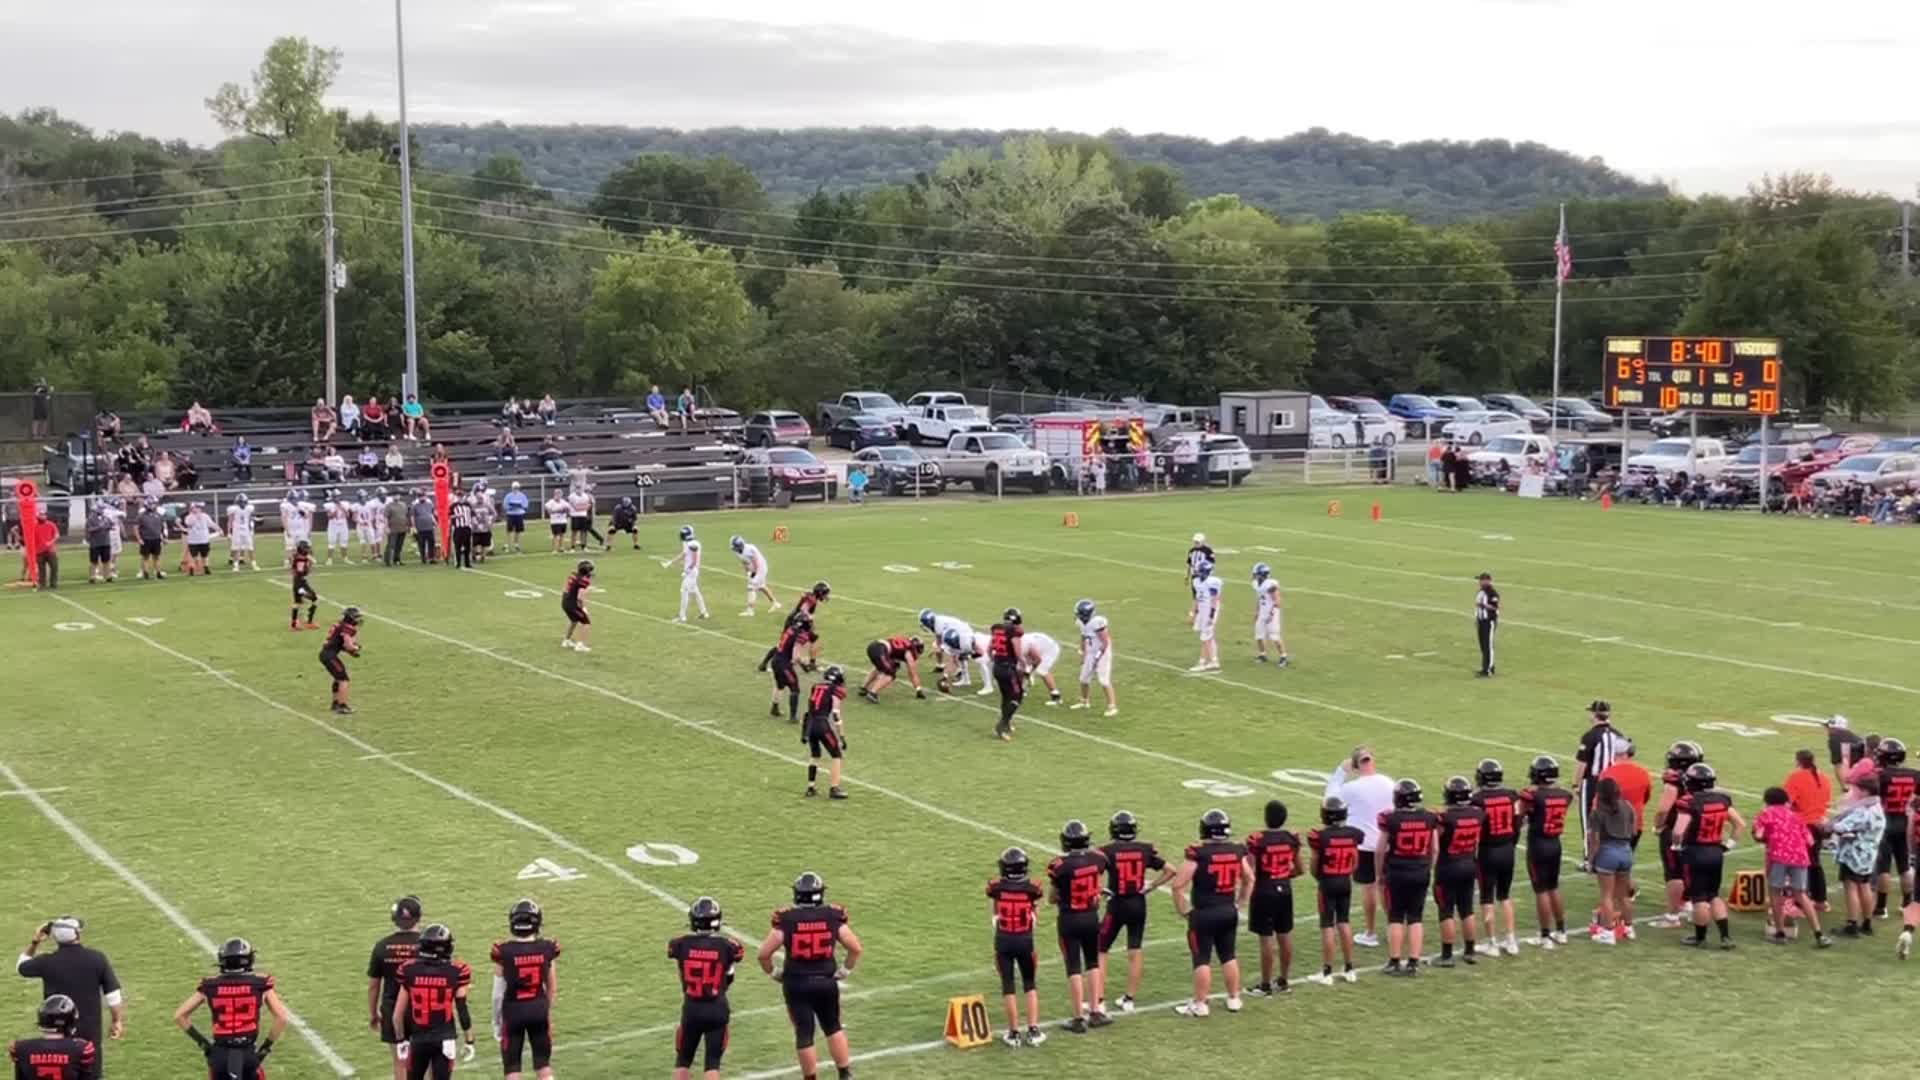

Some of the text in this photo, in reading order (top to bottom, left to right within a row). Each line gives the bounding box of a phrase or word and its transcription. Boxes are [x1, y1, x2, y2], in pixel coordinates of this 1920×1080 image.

[1671, 341, 1721, 363] 8:40
[1618, 357, 1630, 379] 6
[1733, 371, 1744, 387] 2
[1763, 360, 1777, 383] 0
[1660, 387, 1678, 408] 10
[1749, 389, 1777, 412] 30
[1740, 874, 1764, 905] 30
[683, 959, 723, 999] 54
[411, 987, 453, 1024] 94
[961, 1001, 989, 1042] 40
